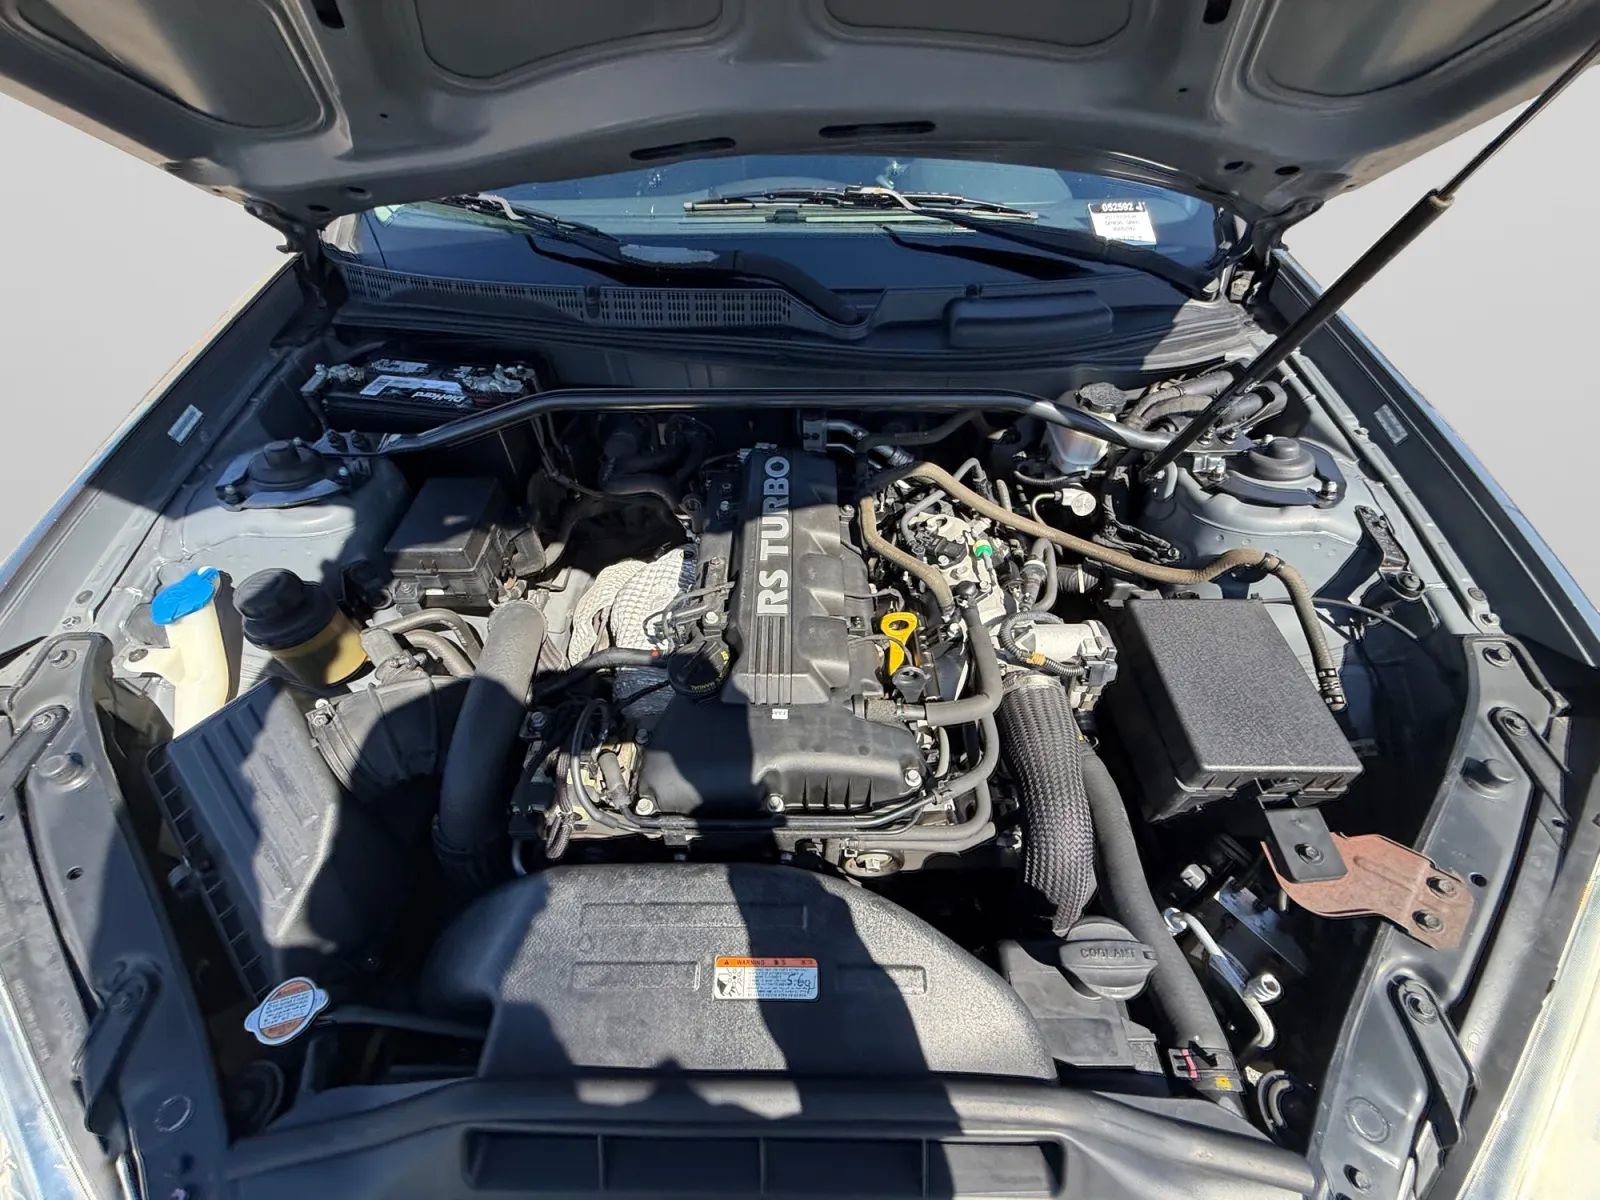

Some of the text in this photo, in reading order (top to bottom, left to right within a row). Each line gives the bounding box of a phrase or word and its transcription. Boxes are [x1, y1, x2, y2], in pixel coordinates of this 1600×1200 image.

[411, 391, 466, 403] DieHard
[757, 456, 790, 614] RS TURBO
[1080, 947, 1136, 958] COOLANT
